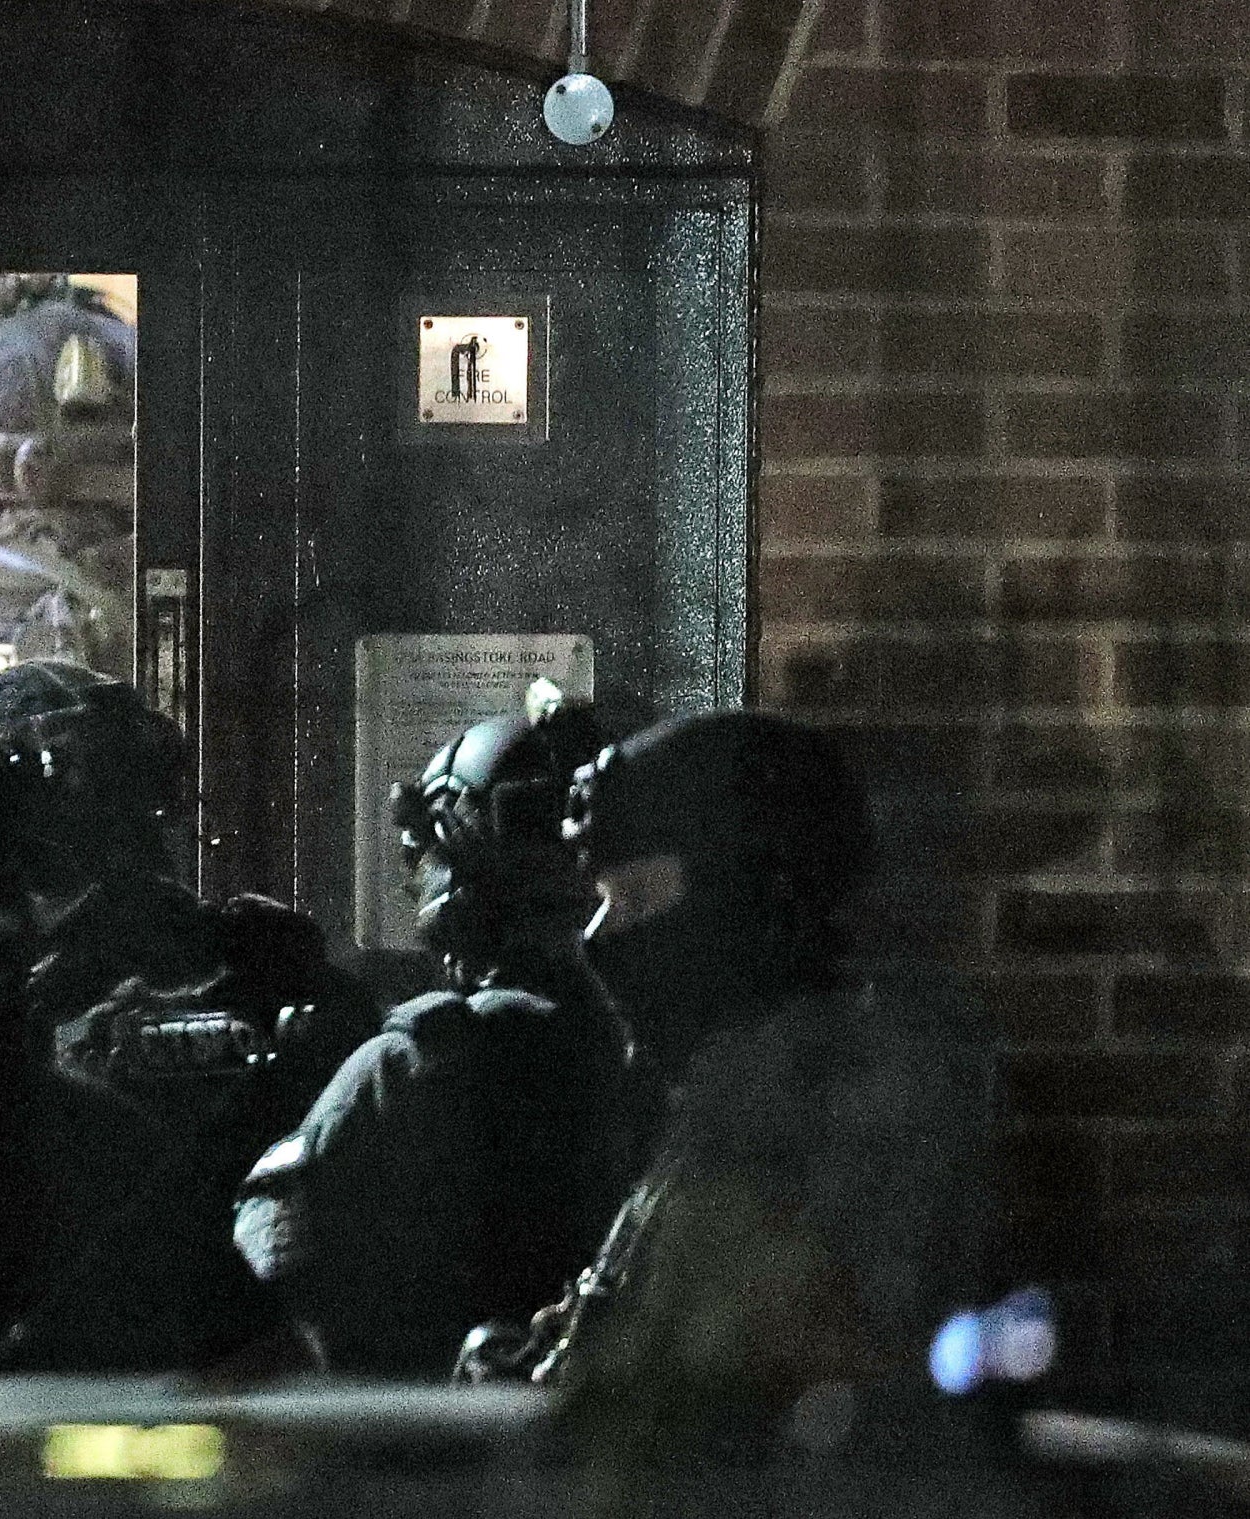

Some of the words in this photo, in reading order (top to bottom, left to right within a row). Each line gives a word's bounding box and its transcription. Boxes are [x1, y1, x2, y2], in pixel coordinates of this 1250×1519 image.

[457, 368, 491, 383] FRE
[434, 389, 513, 404] CONTROL
[519, 650, 556, 664] ROAD
